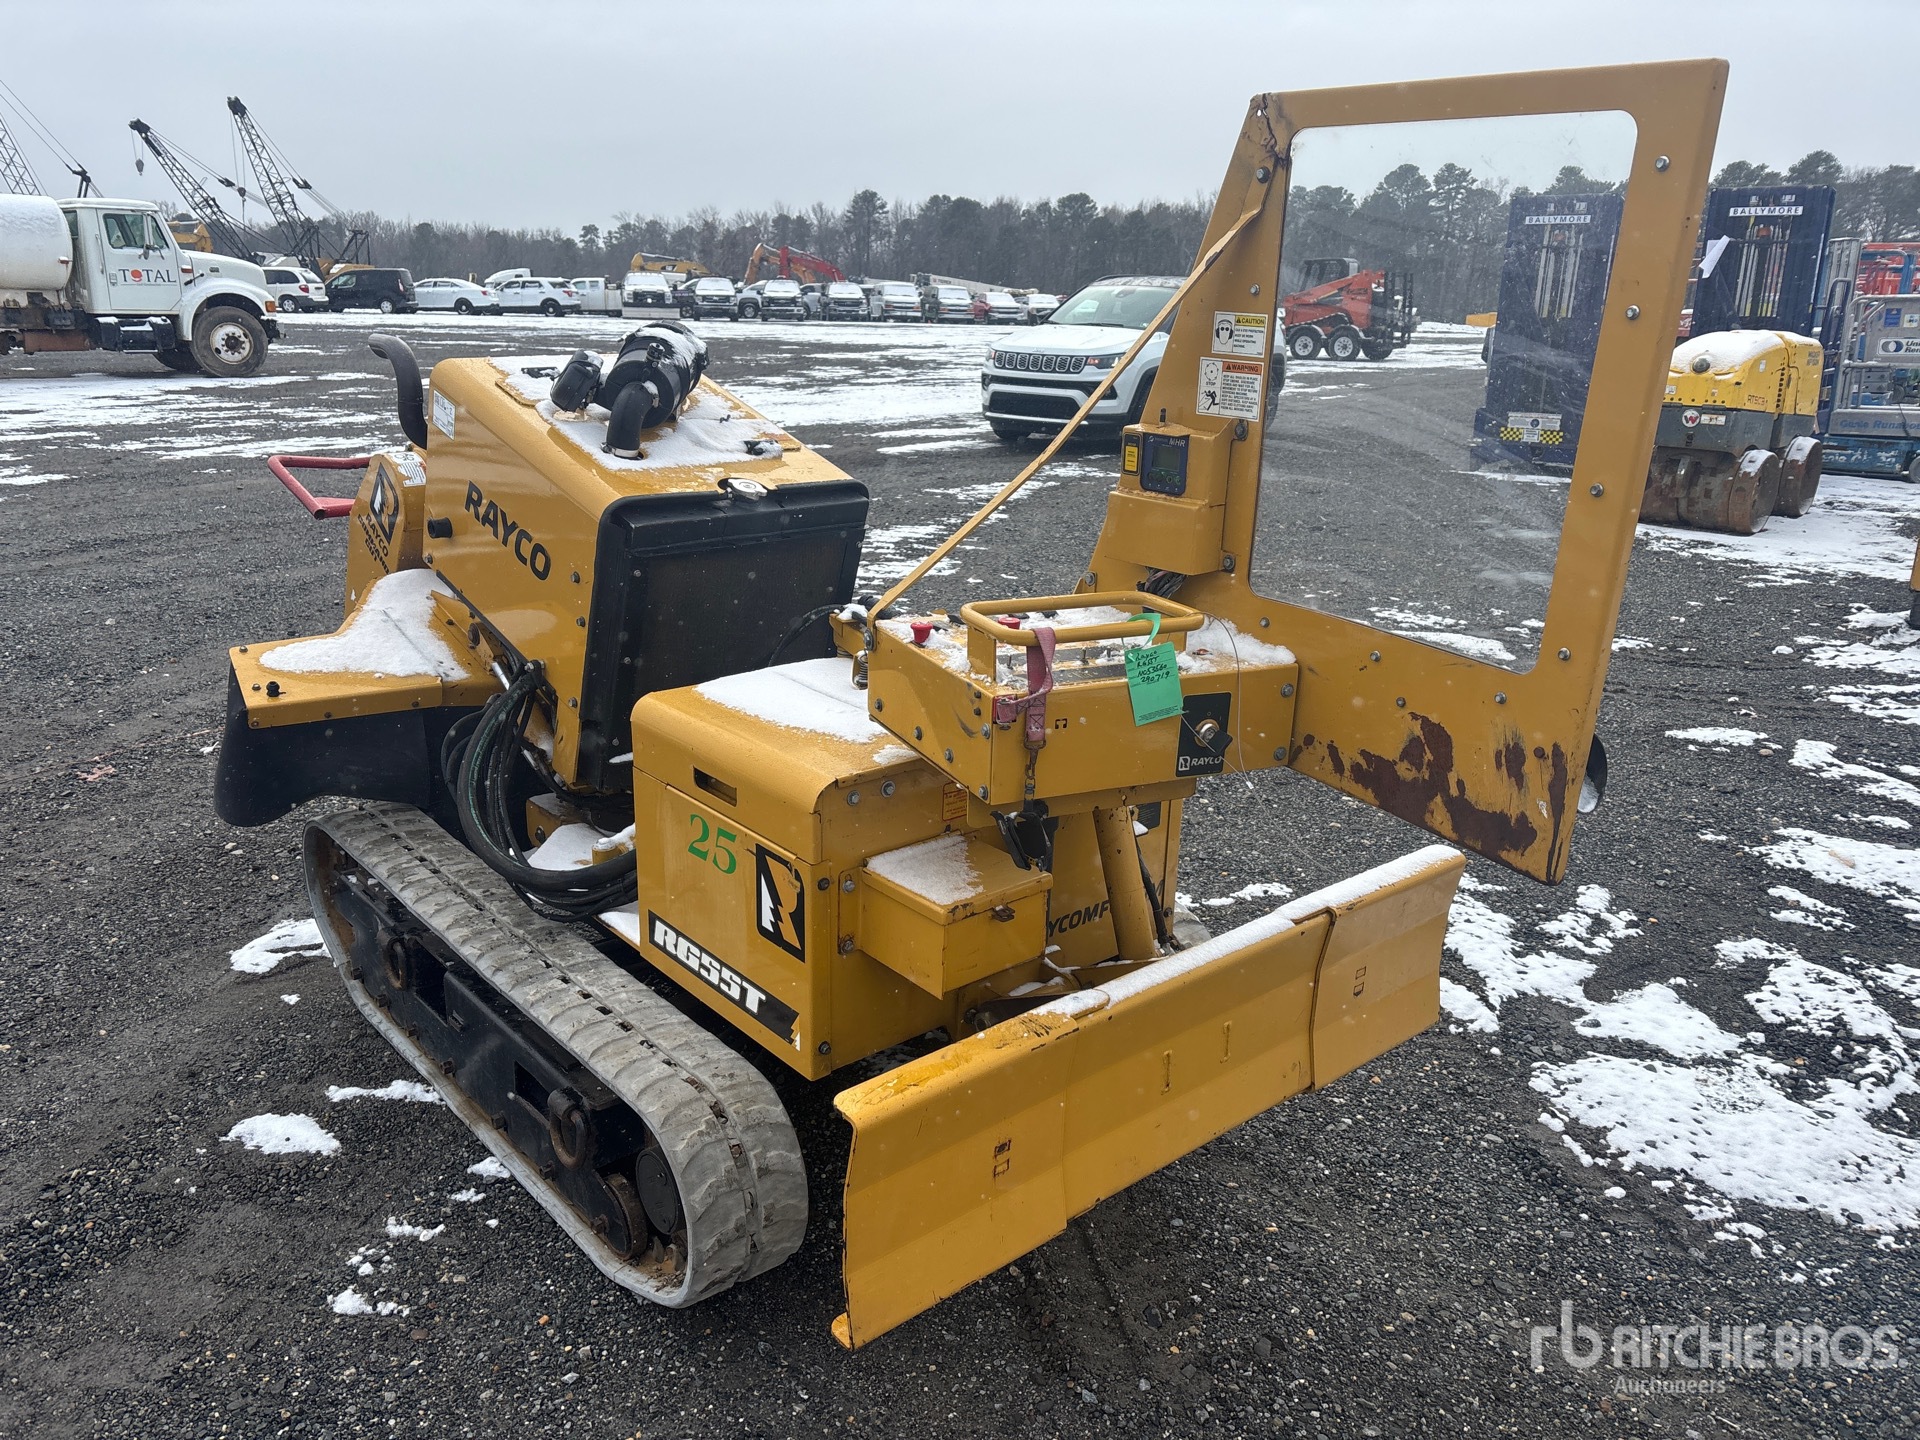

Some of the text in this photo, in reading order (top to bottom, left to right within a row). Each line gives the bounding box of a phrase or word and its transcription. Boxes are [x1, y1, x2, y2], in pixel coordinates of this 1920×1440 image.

[1732, 206, 1800, 215] BALLYMORE
[1528, 215, 1588, 224] BALLYMORE
[118, 268, 177, 283] TOTAL
[1241, 317, 1265, 325] CAUTION
[1231, 364, 1259, 373] WARNING
[1169, 438, 1186, 447] MHR
[366, 513, 389, 557] RAYCO
[465, 480, 551, 581] RAYCO
[365, 538, 378, 562] CUT
[687, 813, 737, 875] 25
[1047, 899, 1111, 938] YCOMF
